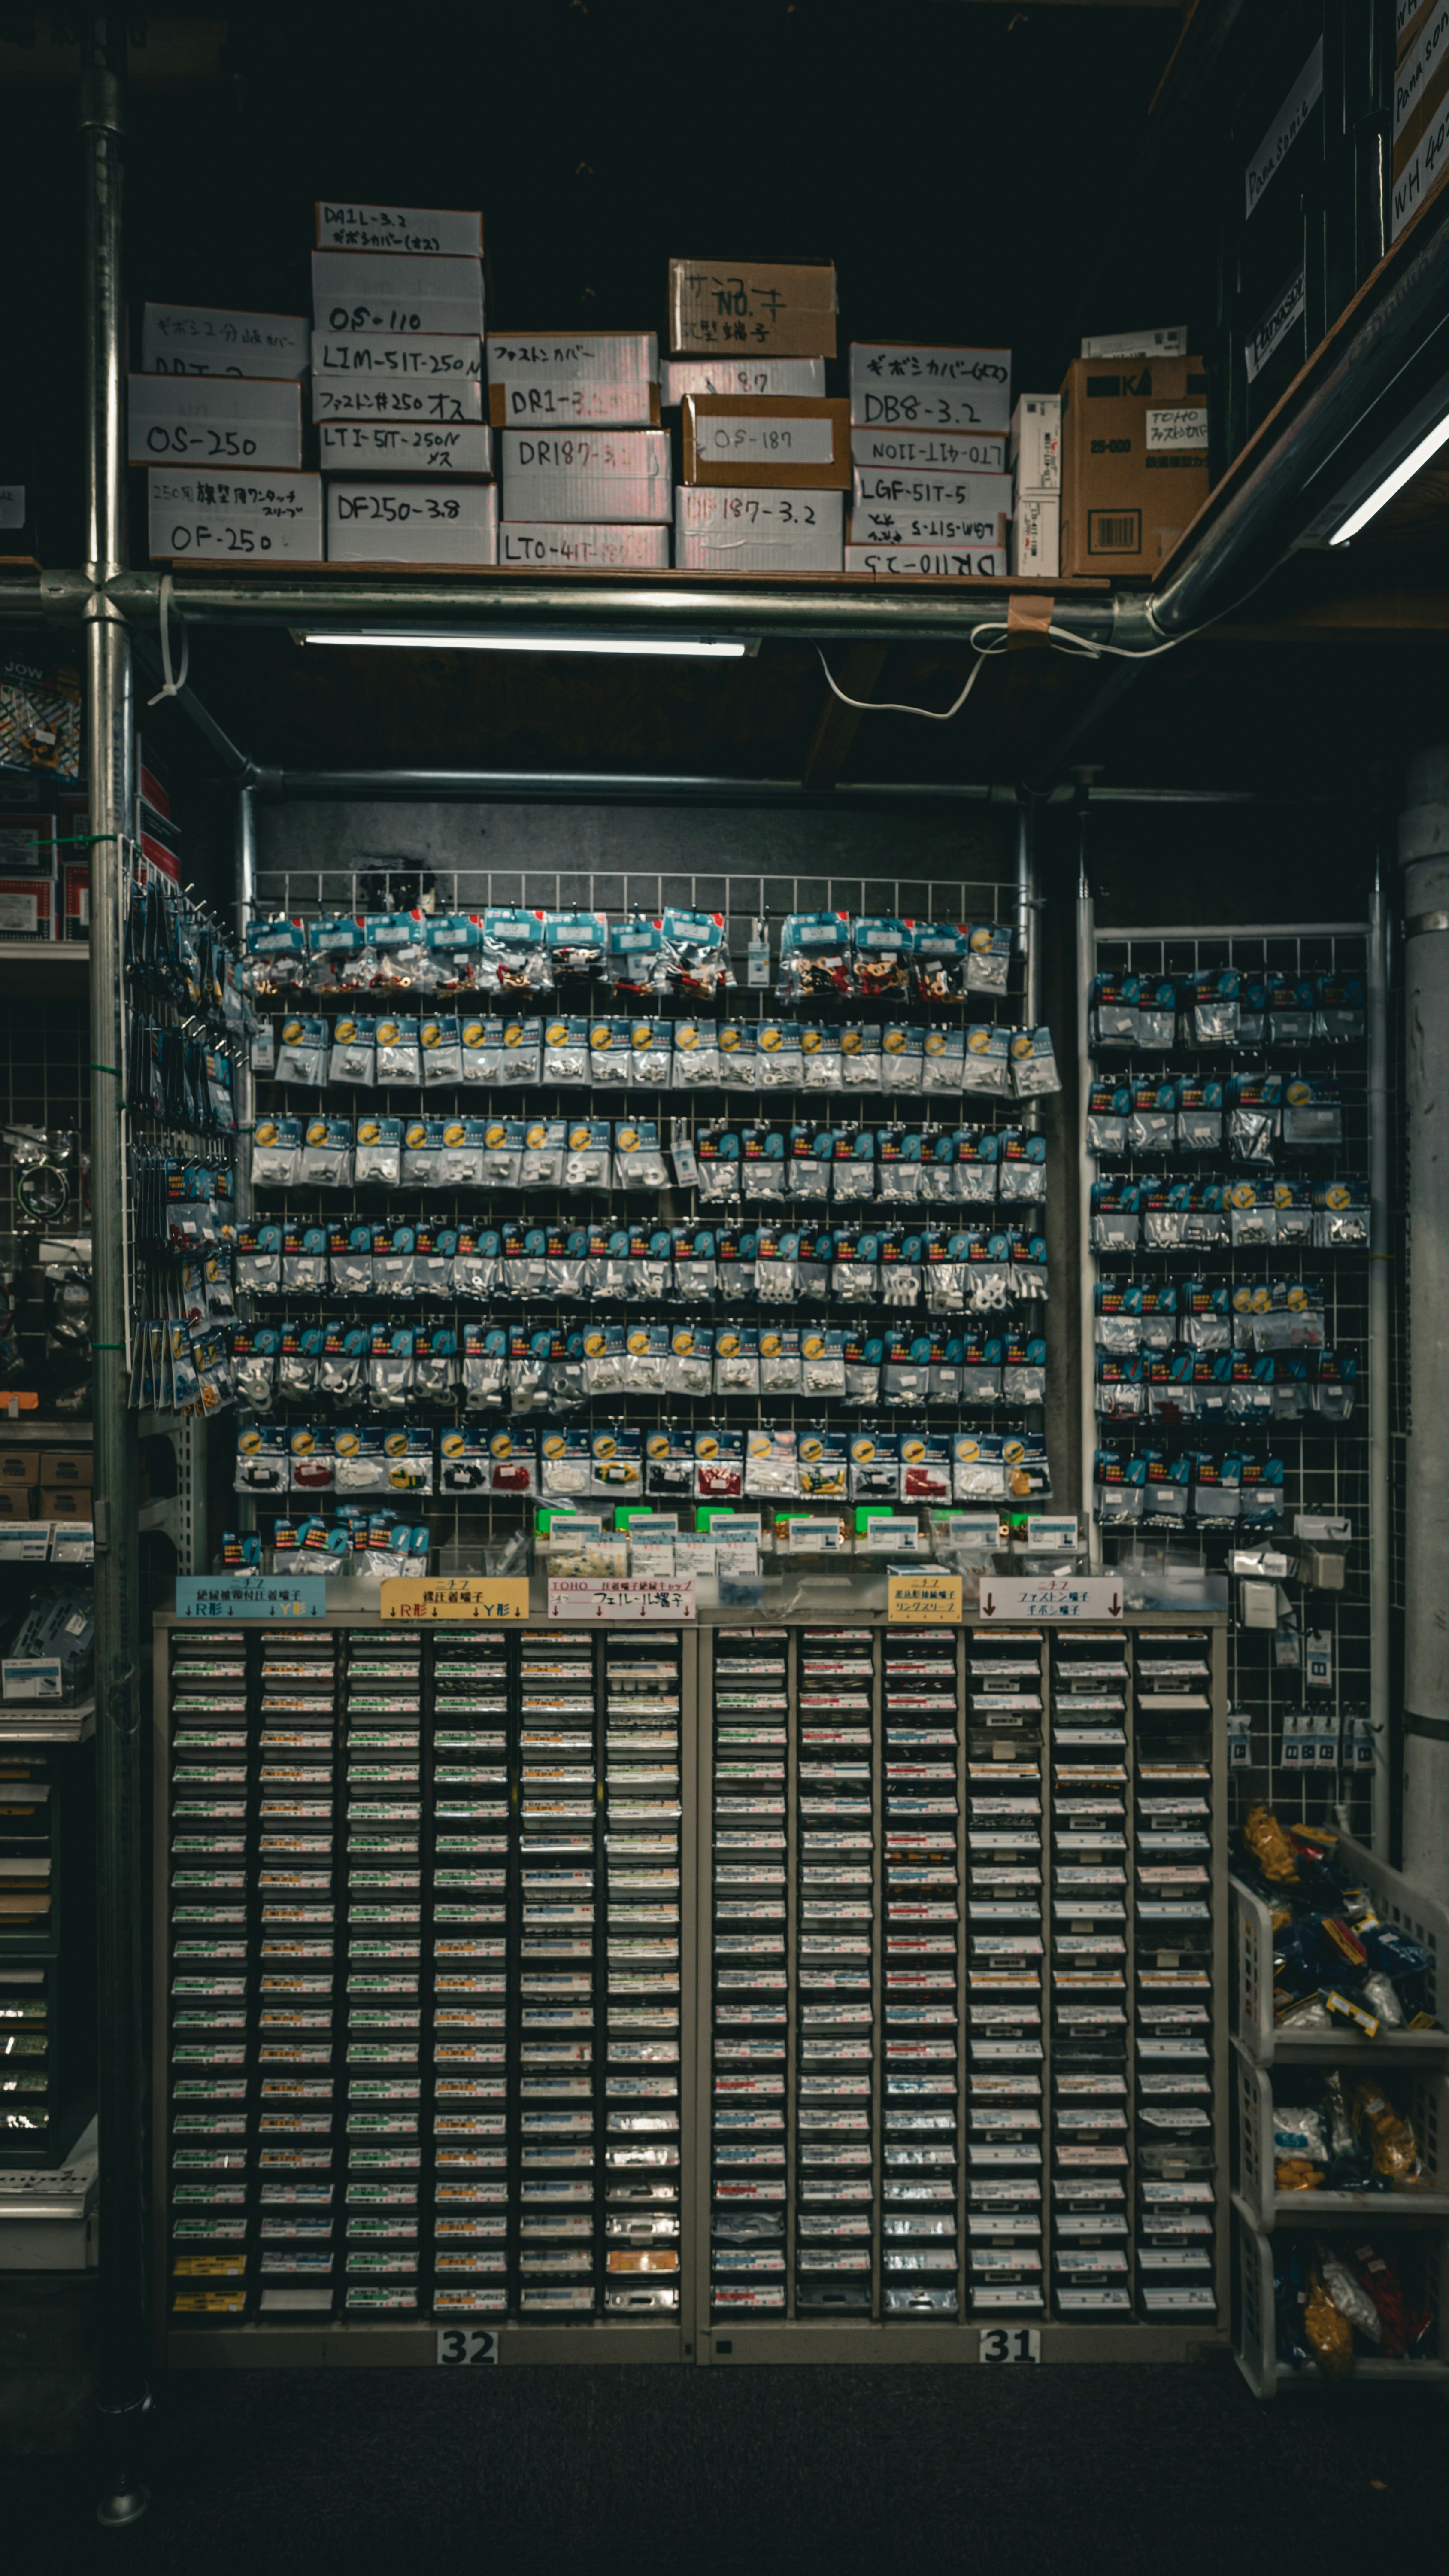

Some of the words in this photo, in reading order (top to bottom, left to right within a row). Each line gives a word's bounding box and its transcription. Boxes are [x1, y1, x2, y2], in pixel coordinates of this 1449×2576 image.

[1395, 158, 1420, 219] WH
[329, 307, 421, 333] OS-110
[864, 392, 982, 424] DB8-3.2
[146, 425, 257, 456] OS-250
[714, 429, 792, 450] OS-187
[338, 495, 460, 521] DF250-3.8
[170, 525, 273, 553] OF-250
[442, 2331, 494, 2363] 32
[985, 2329, 1036, 2362] 31
